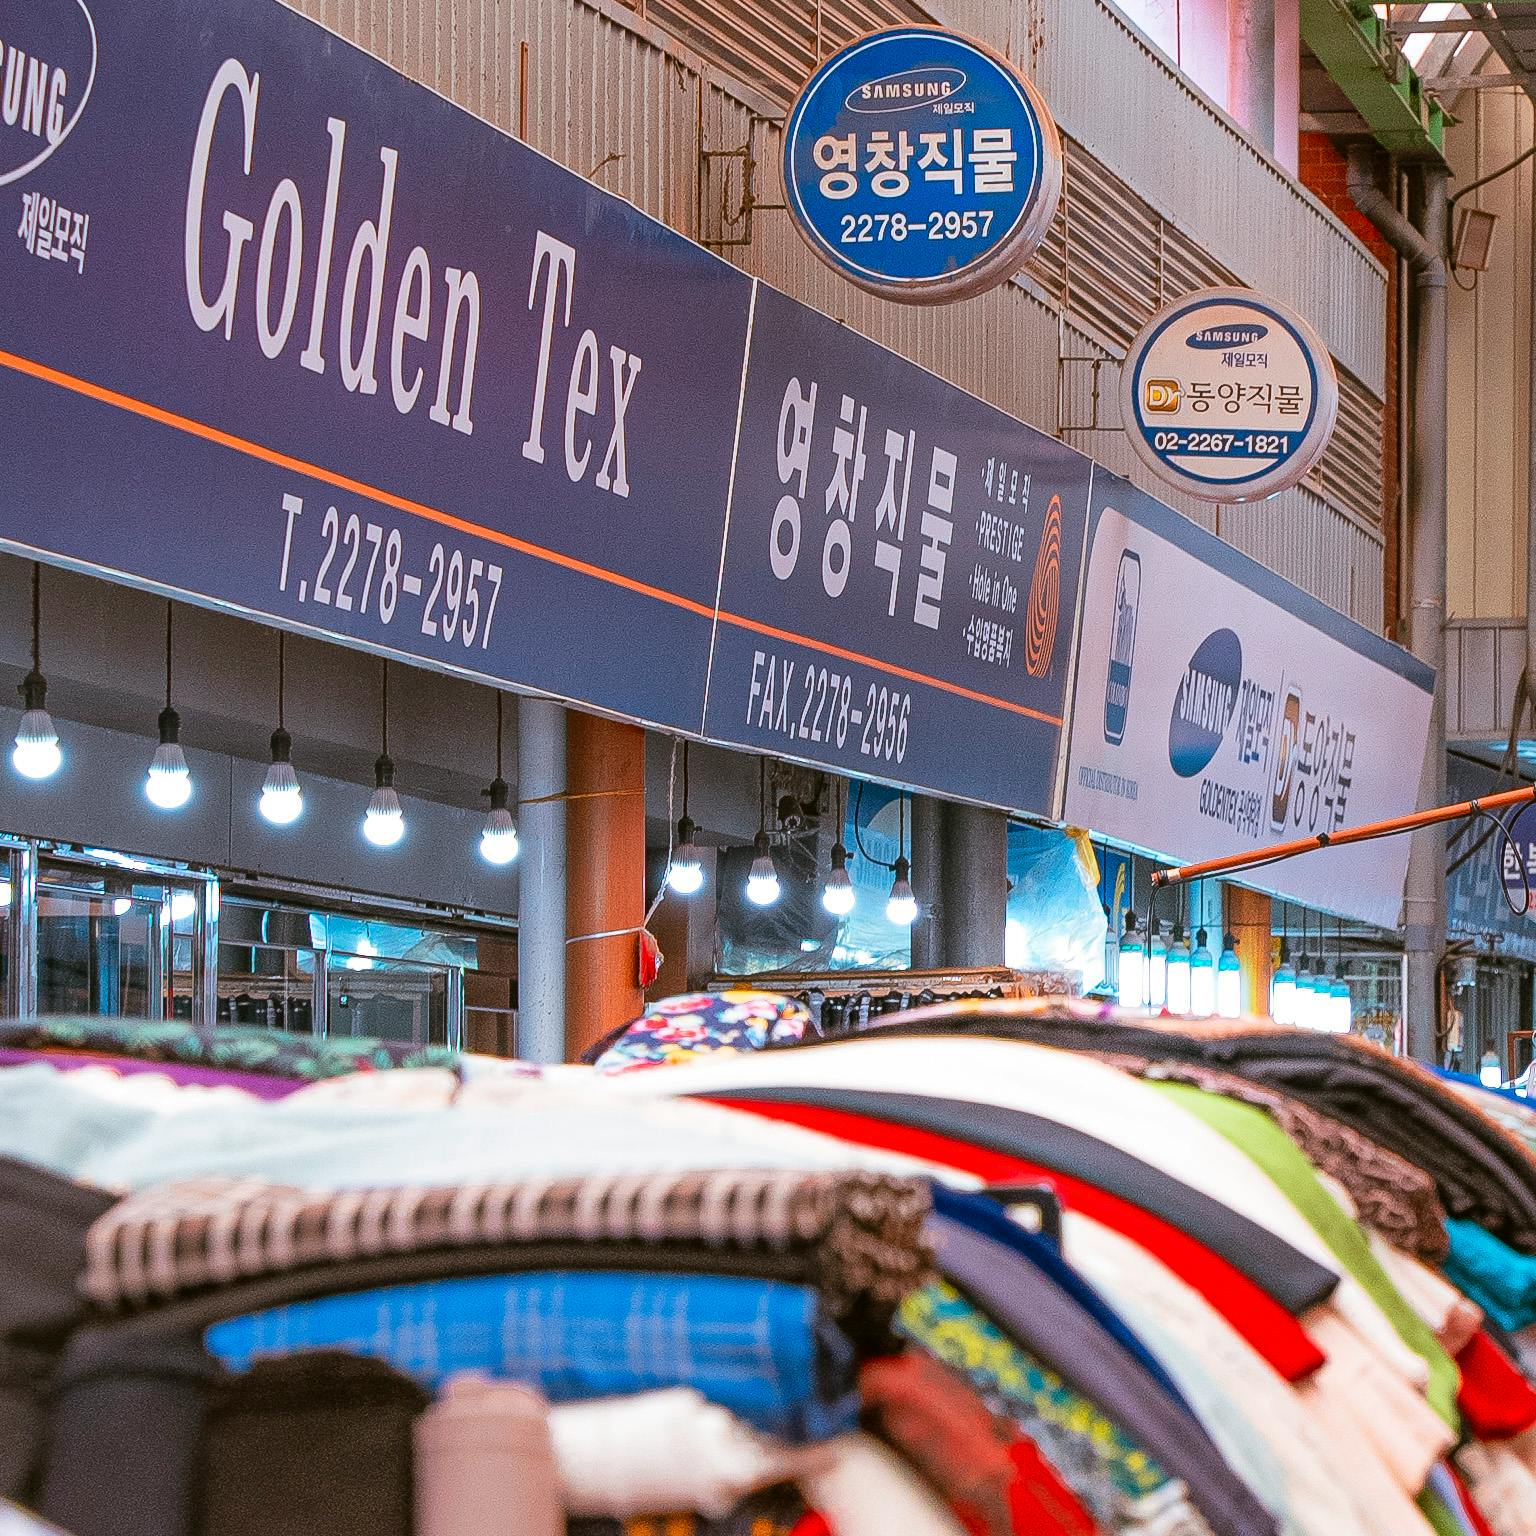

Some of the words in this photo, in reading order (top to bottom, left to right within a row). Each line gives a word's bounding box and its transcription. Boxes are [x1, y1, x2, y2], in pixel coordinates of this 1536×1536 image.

[861, 81, 952, 100] SAMSUNG
[932, 102, 975, 115] 제일모직
[812, 128, 1018, 201] 영창직물
[17, 189, 91, 275] 제일모직
[840, 210, 994, 244] 2278-2957
[184, 57, 485, 436] Golden
[522, 229, 643, 499] Tex
[1195, 330, 1260, 343] SAMSUNG
[1221, 352, 1269, 369] 제일모직
[1186, 381, 1304, 415] 동양직물
[1154, 431, 1289, 454] 02-2267-1821
[768, 373, 959, 631] 영창직물
[977, 510, 1025, 562] PRESTIGE
[278, 491, 504, 651] T.2278-2957
[971, 563, 991, 605] Hole
[991, 571, 1001, 607] in
[1001, 575, 1018, 614] One
[1179, 668, 1234, 739] SAMSUNG
[1294, 710, 1357, 833] 동양직물
